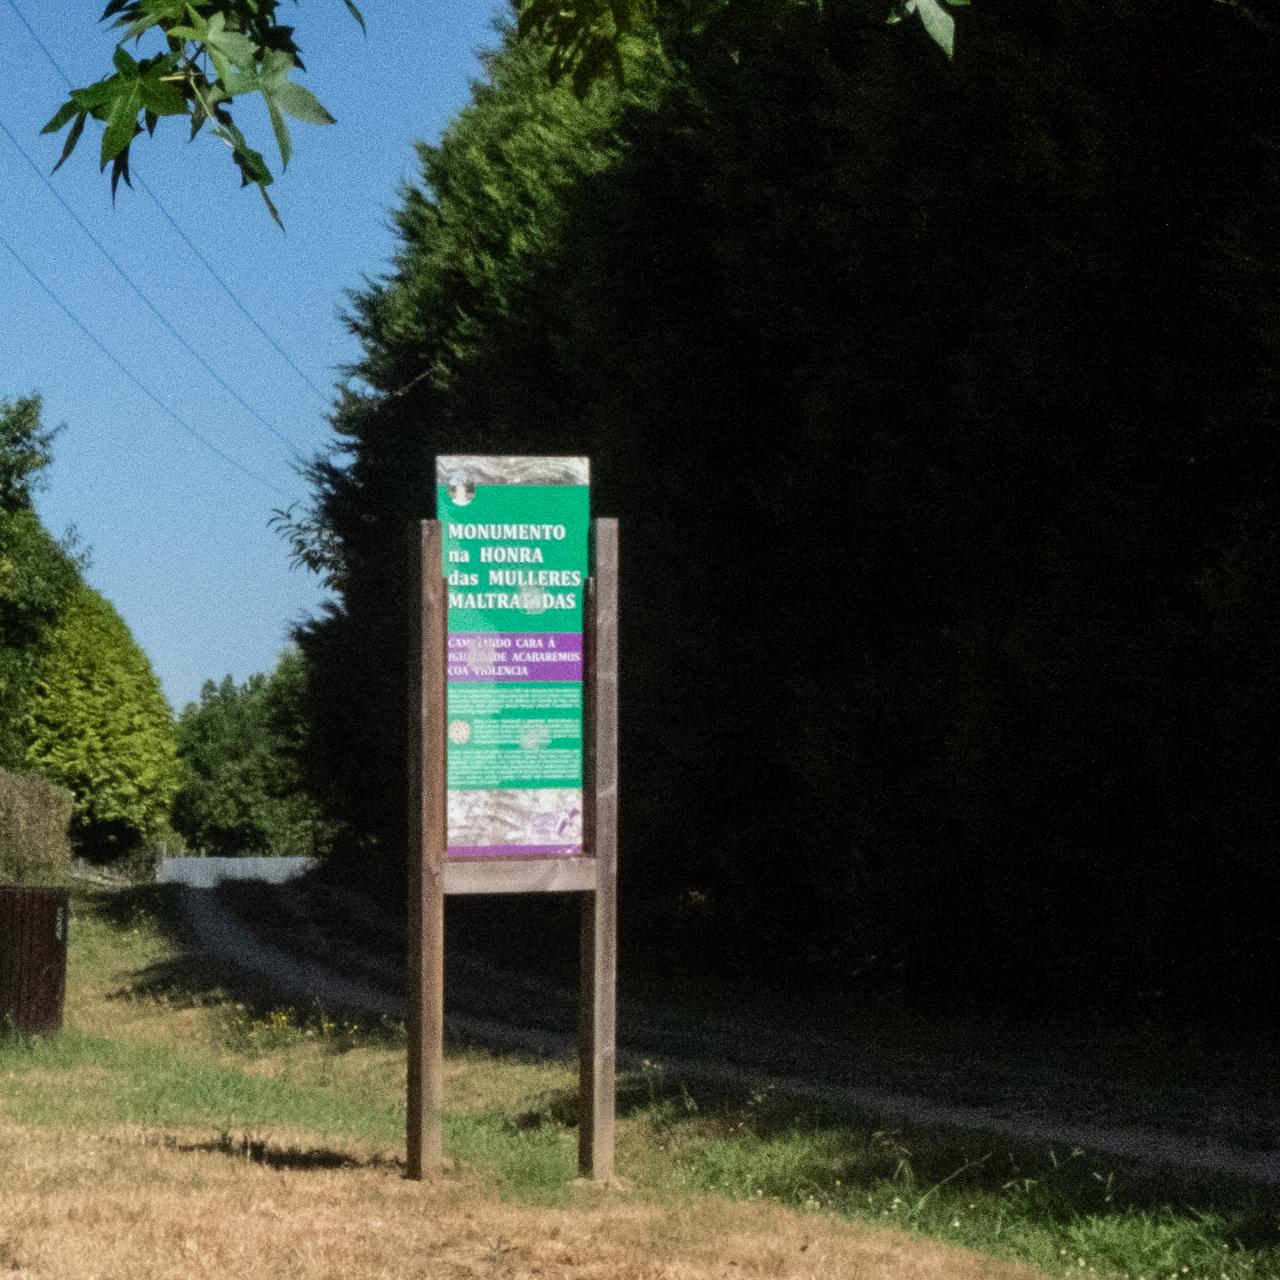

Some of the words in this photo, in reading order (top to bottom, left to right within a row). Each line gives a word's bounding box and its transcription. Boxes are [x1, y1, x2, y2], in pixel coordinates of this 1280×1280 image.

[448, 524, 566, 540] MONUMENTO
[448, 550, 470, 563] na
[480, 547, 544, 563] HONRA
[448, 570, 479, 586] das
[489, 570, 581, 586] MULLERES
[448, 593, 576, 609] MALTRADAS
[448, 636, 511, 648] CAMANDO
[516, 639, 543, 648] CARA
[448, 652, 507, 662] IGUDE
[513, 652, 580, 662] ACABAREMOS
[448, 666, 468, 675] COA
